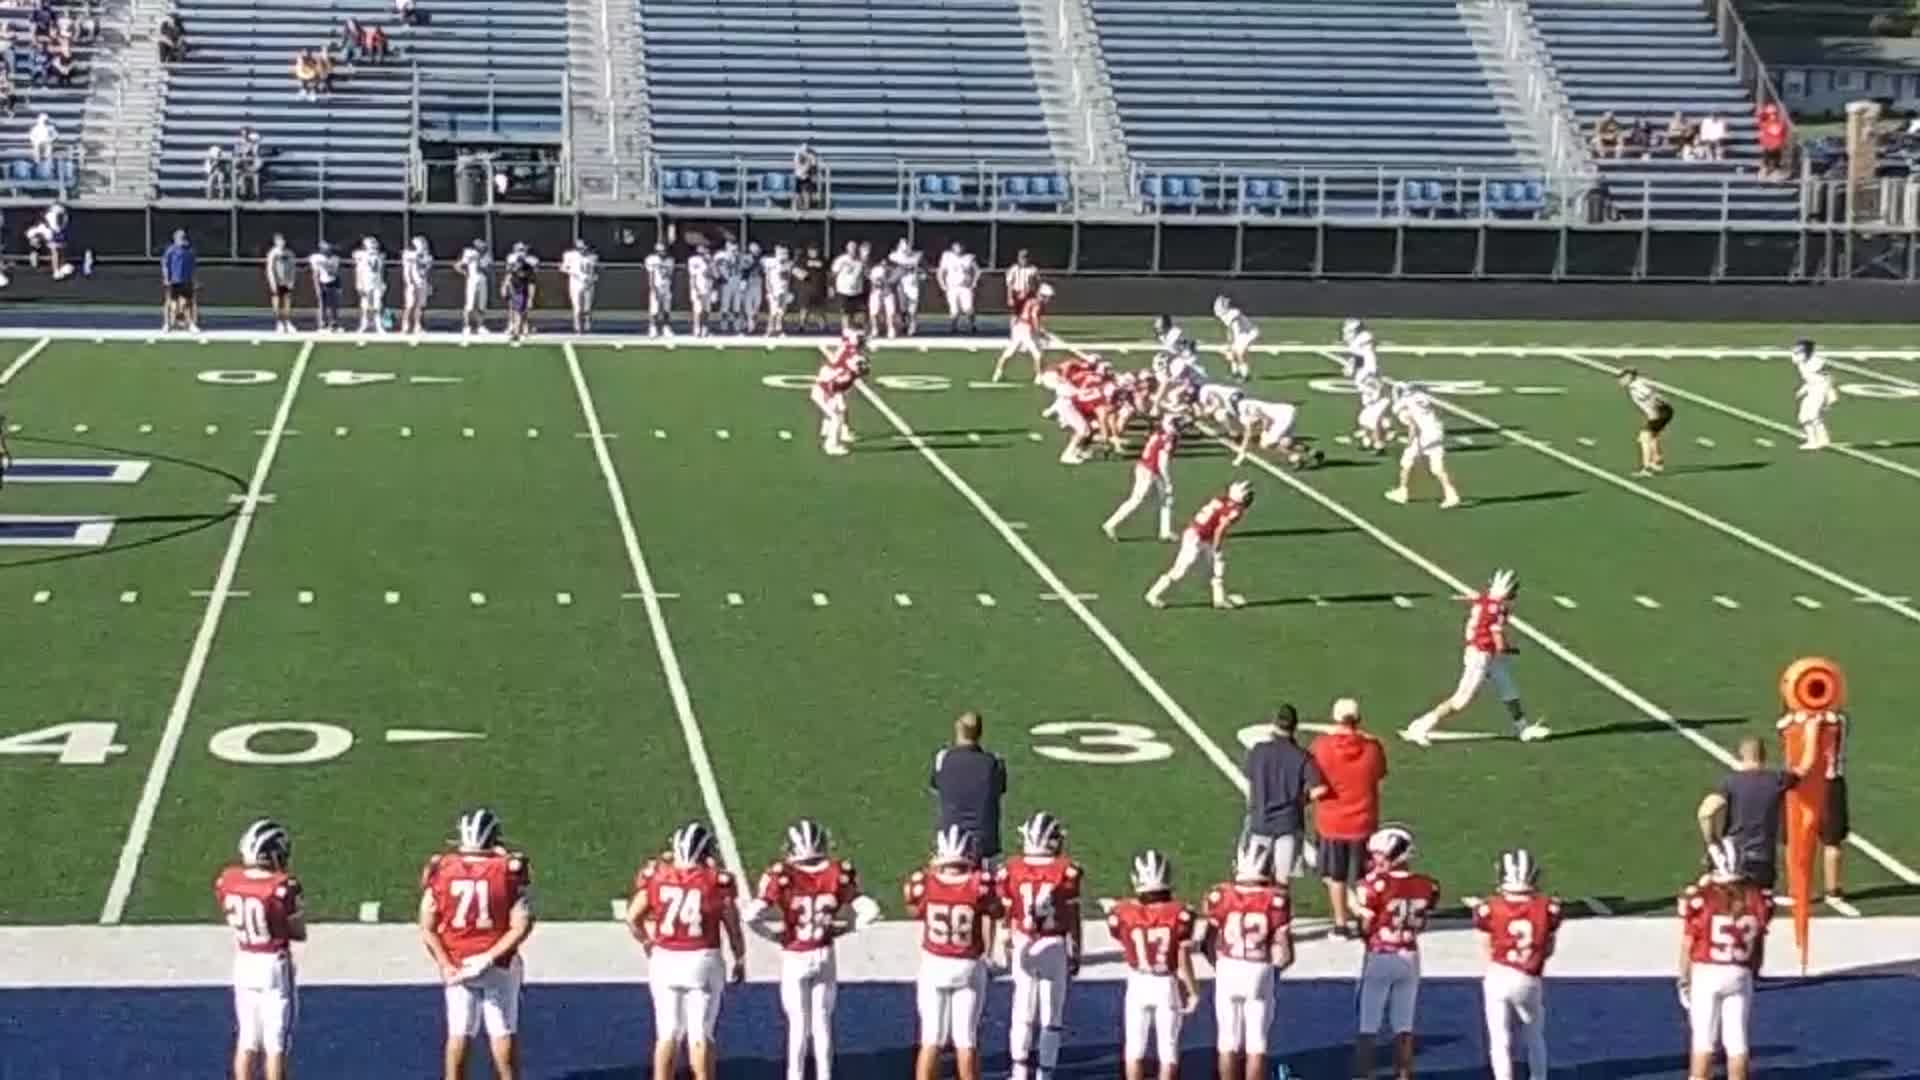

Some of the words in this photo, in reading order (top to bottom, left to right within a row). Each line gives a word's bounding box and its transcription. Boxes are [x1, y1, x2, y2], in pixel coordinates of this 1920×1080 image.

[450, 878, 493, 929] 71
[659, 885, 703, 937] 74
[926, 902, 974, 946] 58
[1019, 881, 1060, 930] 14
[1130, 926, 1170, 973] 17
[1506, 918, 1532, 963] 3
[1709, 913, 1758, 962] 53
